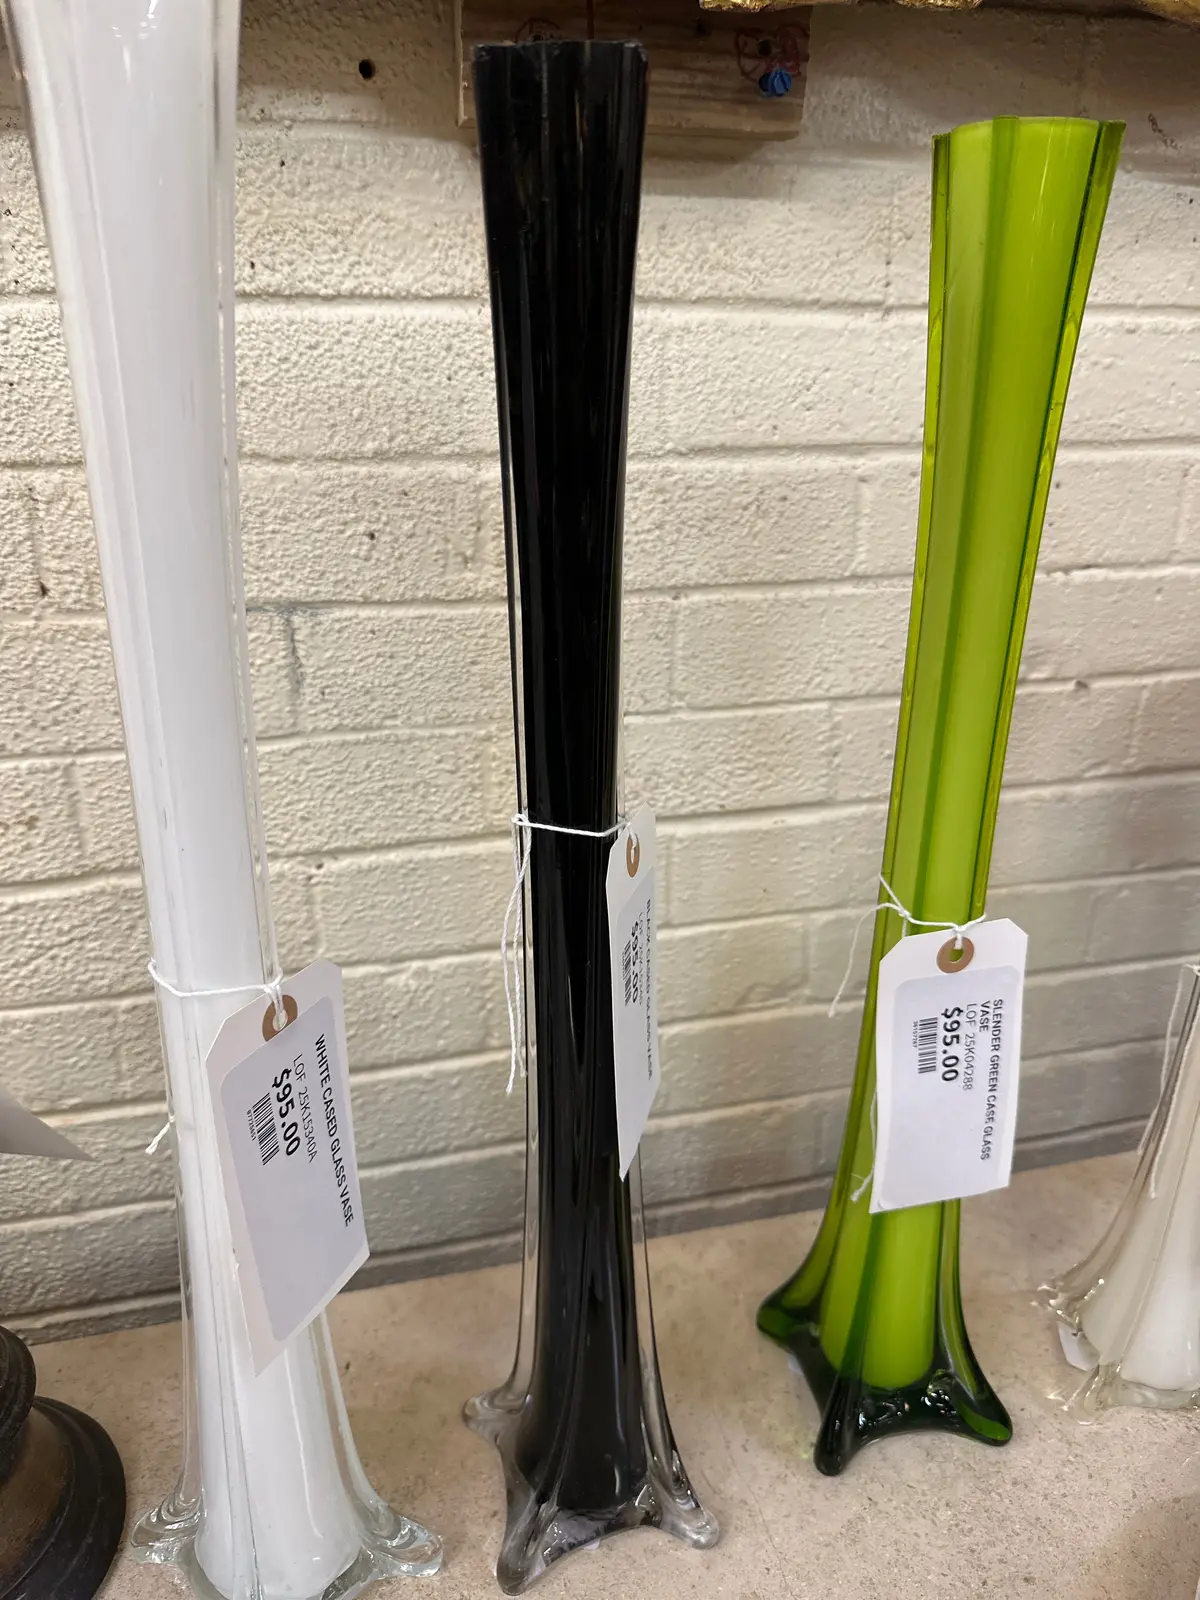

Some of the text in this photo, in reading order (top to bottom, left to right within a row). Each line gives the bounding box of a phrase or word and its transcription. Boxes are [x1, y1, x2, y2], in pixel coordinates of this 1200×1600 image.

[631, 921, 639, 1004] $95.00
[941, 1006, 964, 1082] $95.00
[963, 1003, 977, 1091] LOF 25K04288
[979, 1000, 991, 1033] VASE
[272, 1068, 301, 1157] $95.00
[293, 1054, 318, 1164] LOF 25K15340A
[980, 999, 1003, 1161] SLENDER GREEN CASE GLASS
[315, 1033, 354, 1227] WHITE CASED GLASS VASE
